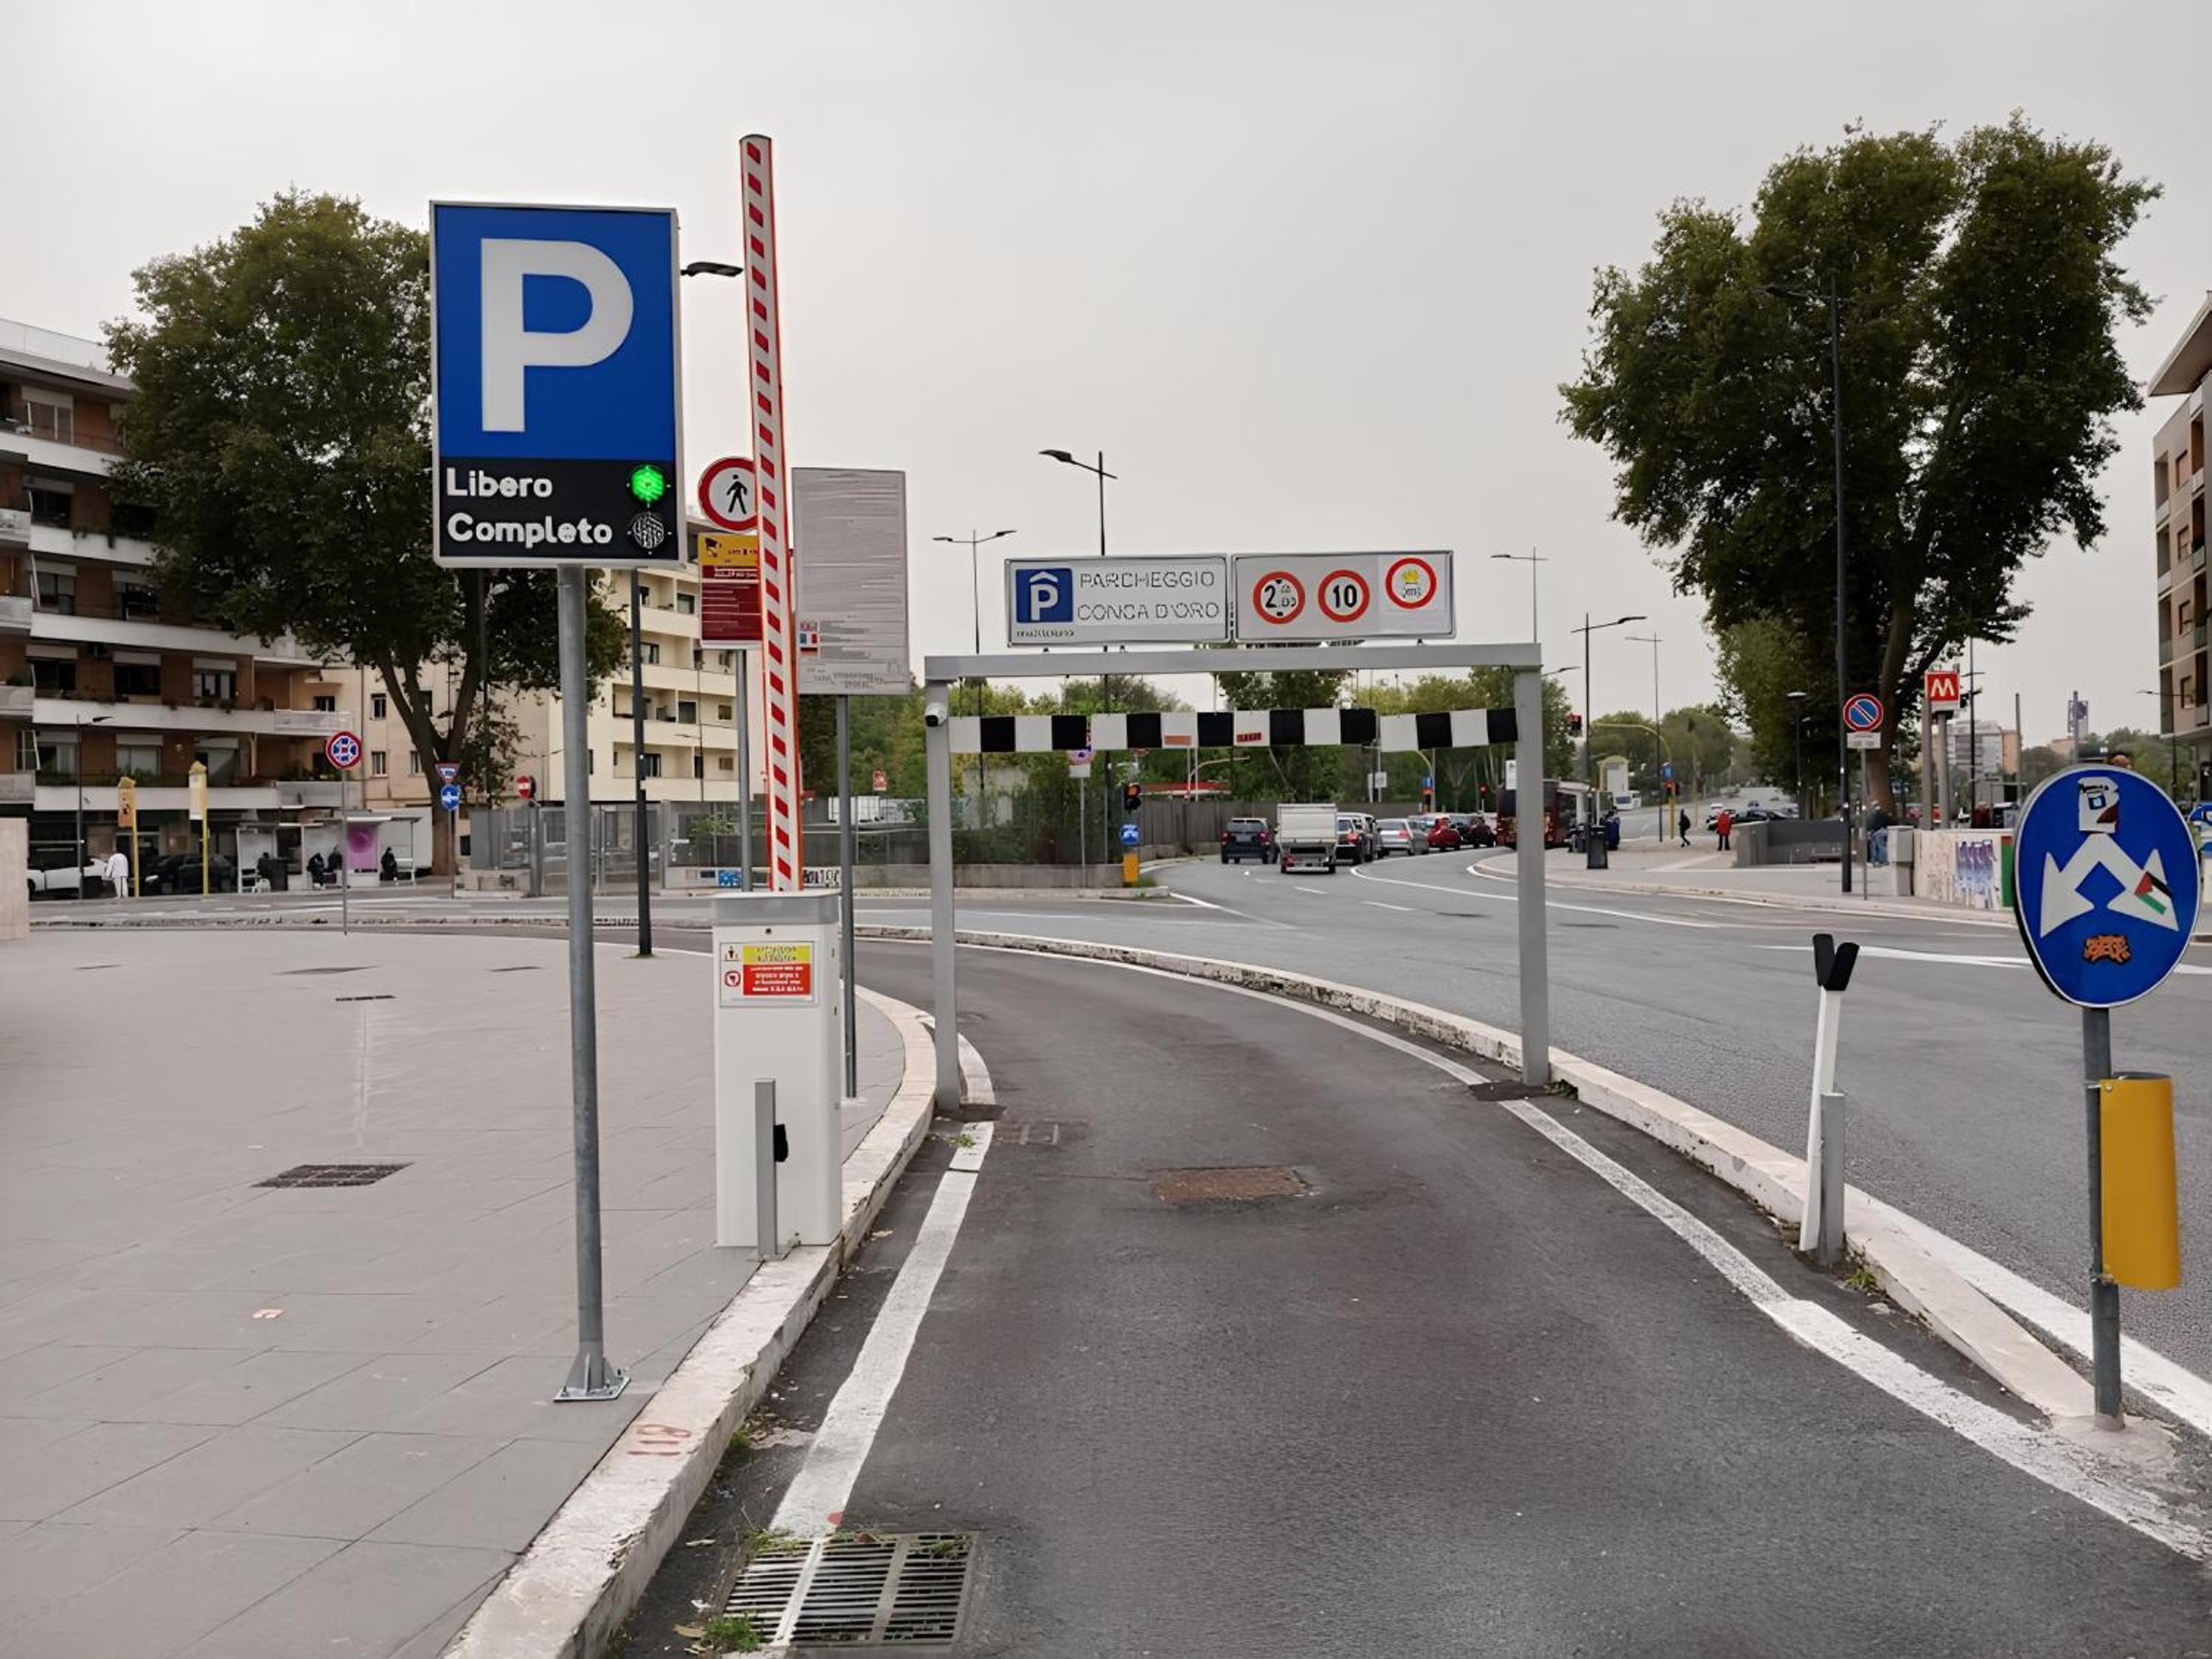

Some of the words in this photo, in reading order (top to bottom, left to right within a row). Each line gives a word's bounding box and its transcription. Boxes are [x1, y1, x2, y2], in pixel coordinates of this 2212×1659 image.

[481, 237, 634, 433] P
[446, 467, 553, 498] Libero
[447, 512, 613, 549] Completo
[1079, 571, 1215, 588] PARCHEGGIO
[1332, 584, 1358, 608] 10
[1077, 603, 1150, 621] CONCA
